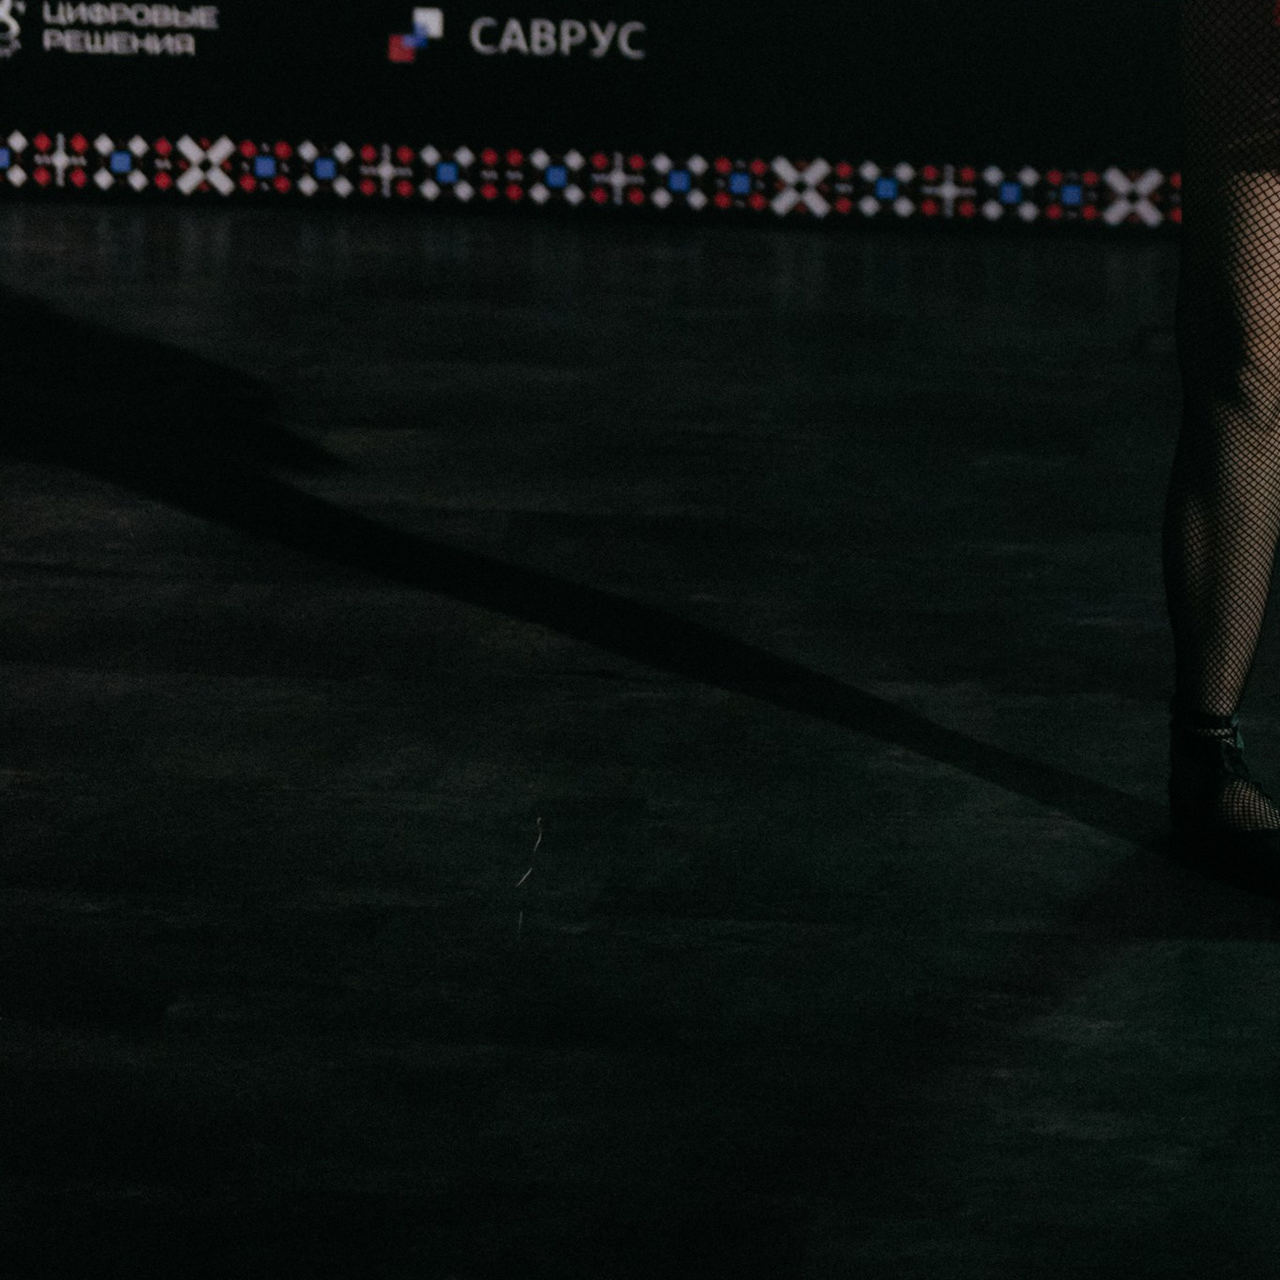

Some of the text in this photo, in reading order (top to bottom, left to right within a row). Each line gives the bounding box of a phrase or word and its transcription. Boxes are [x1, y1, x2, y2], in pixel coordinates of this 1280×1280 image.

[42, 0, 220, 30] ЦИФРОВЫЕ
[42, 27, 196, 56] РЕШЕНИЯ
[469, 16, 646, 60] САВРУС
